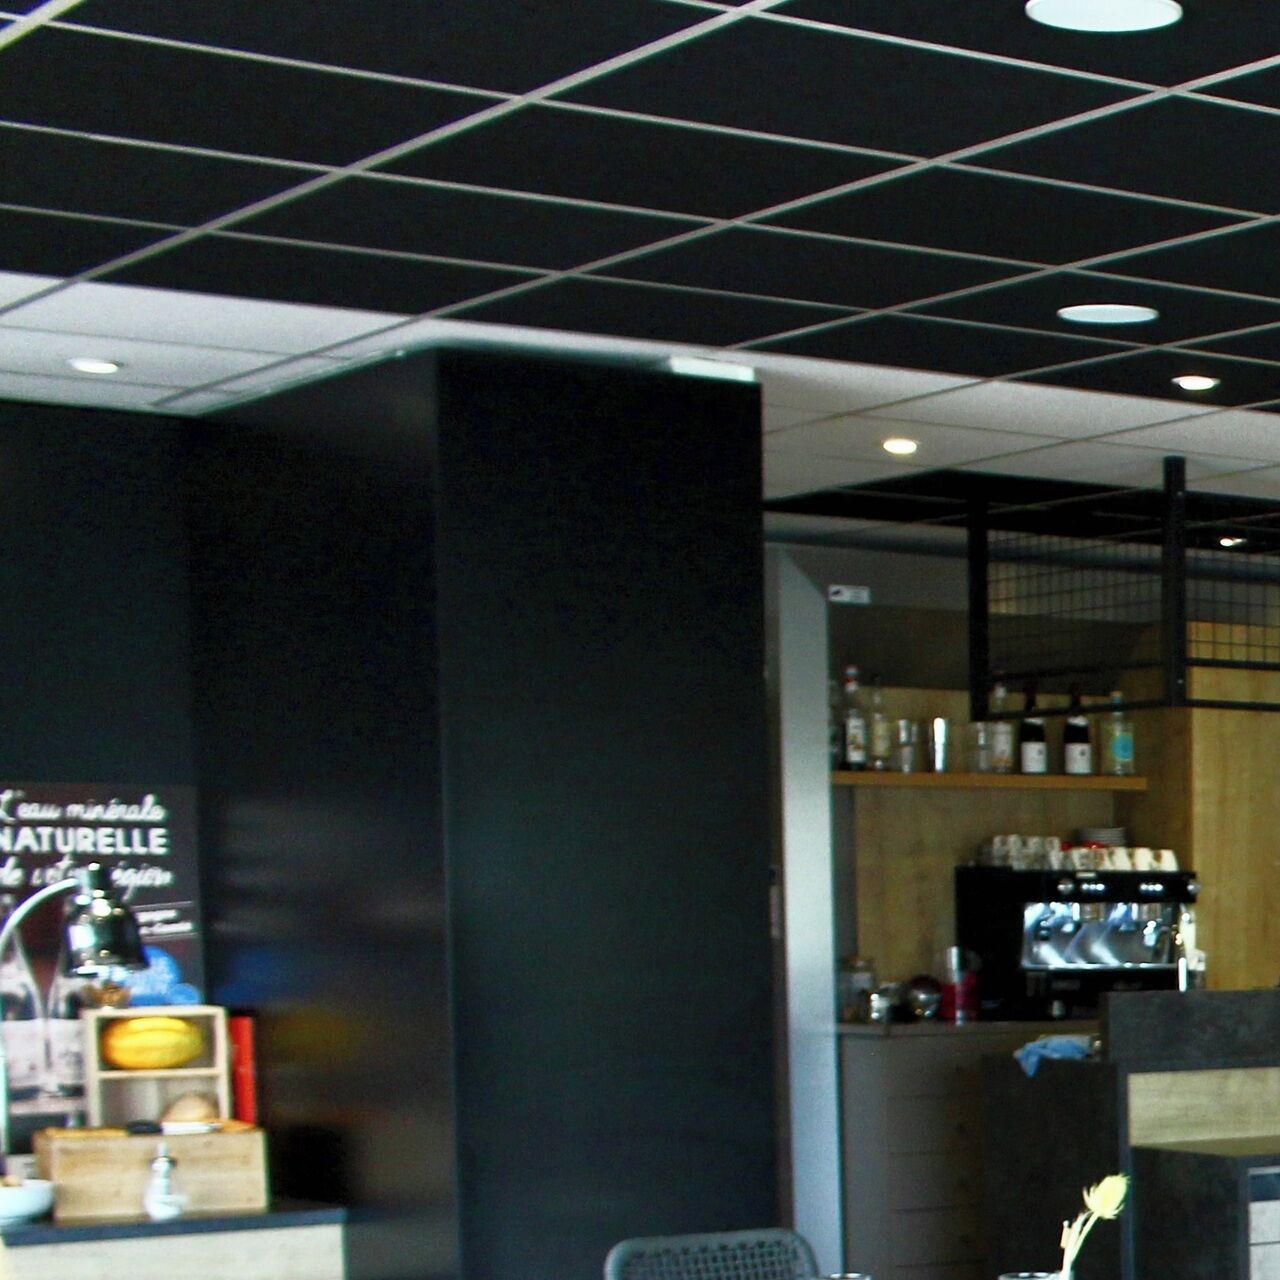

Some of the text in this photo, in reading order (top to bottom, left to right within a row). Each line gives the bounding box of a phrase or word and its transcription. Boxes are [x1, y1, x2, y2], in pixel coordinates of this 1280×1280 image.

[0, 789, 167, 824] L'eau minérale
[0, 826, 169, 856] NATURELLE
